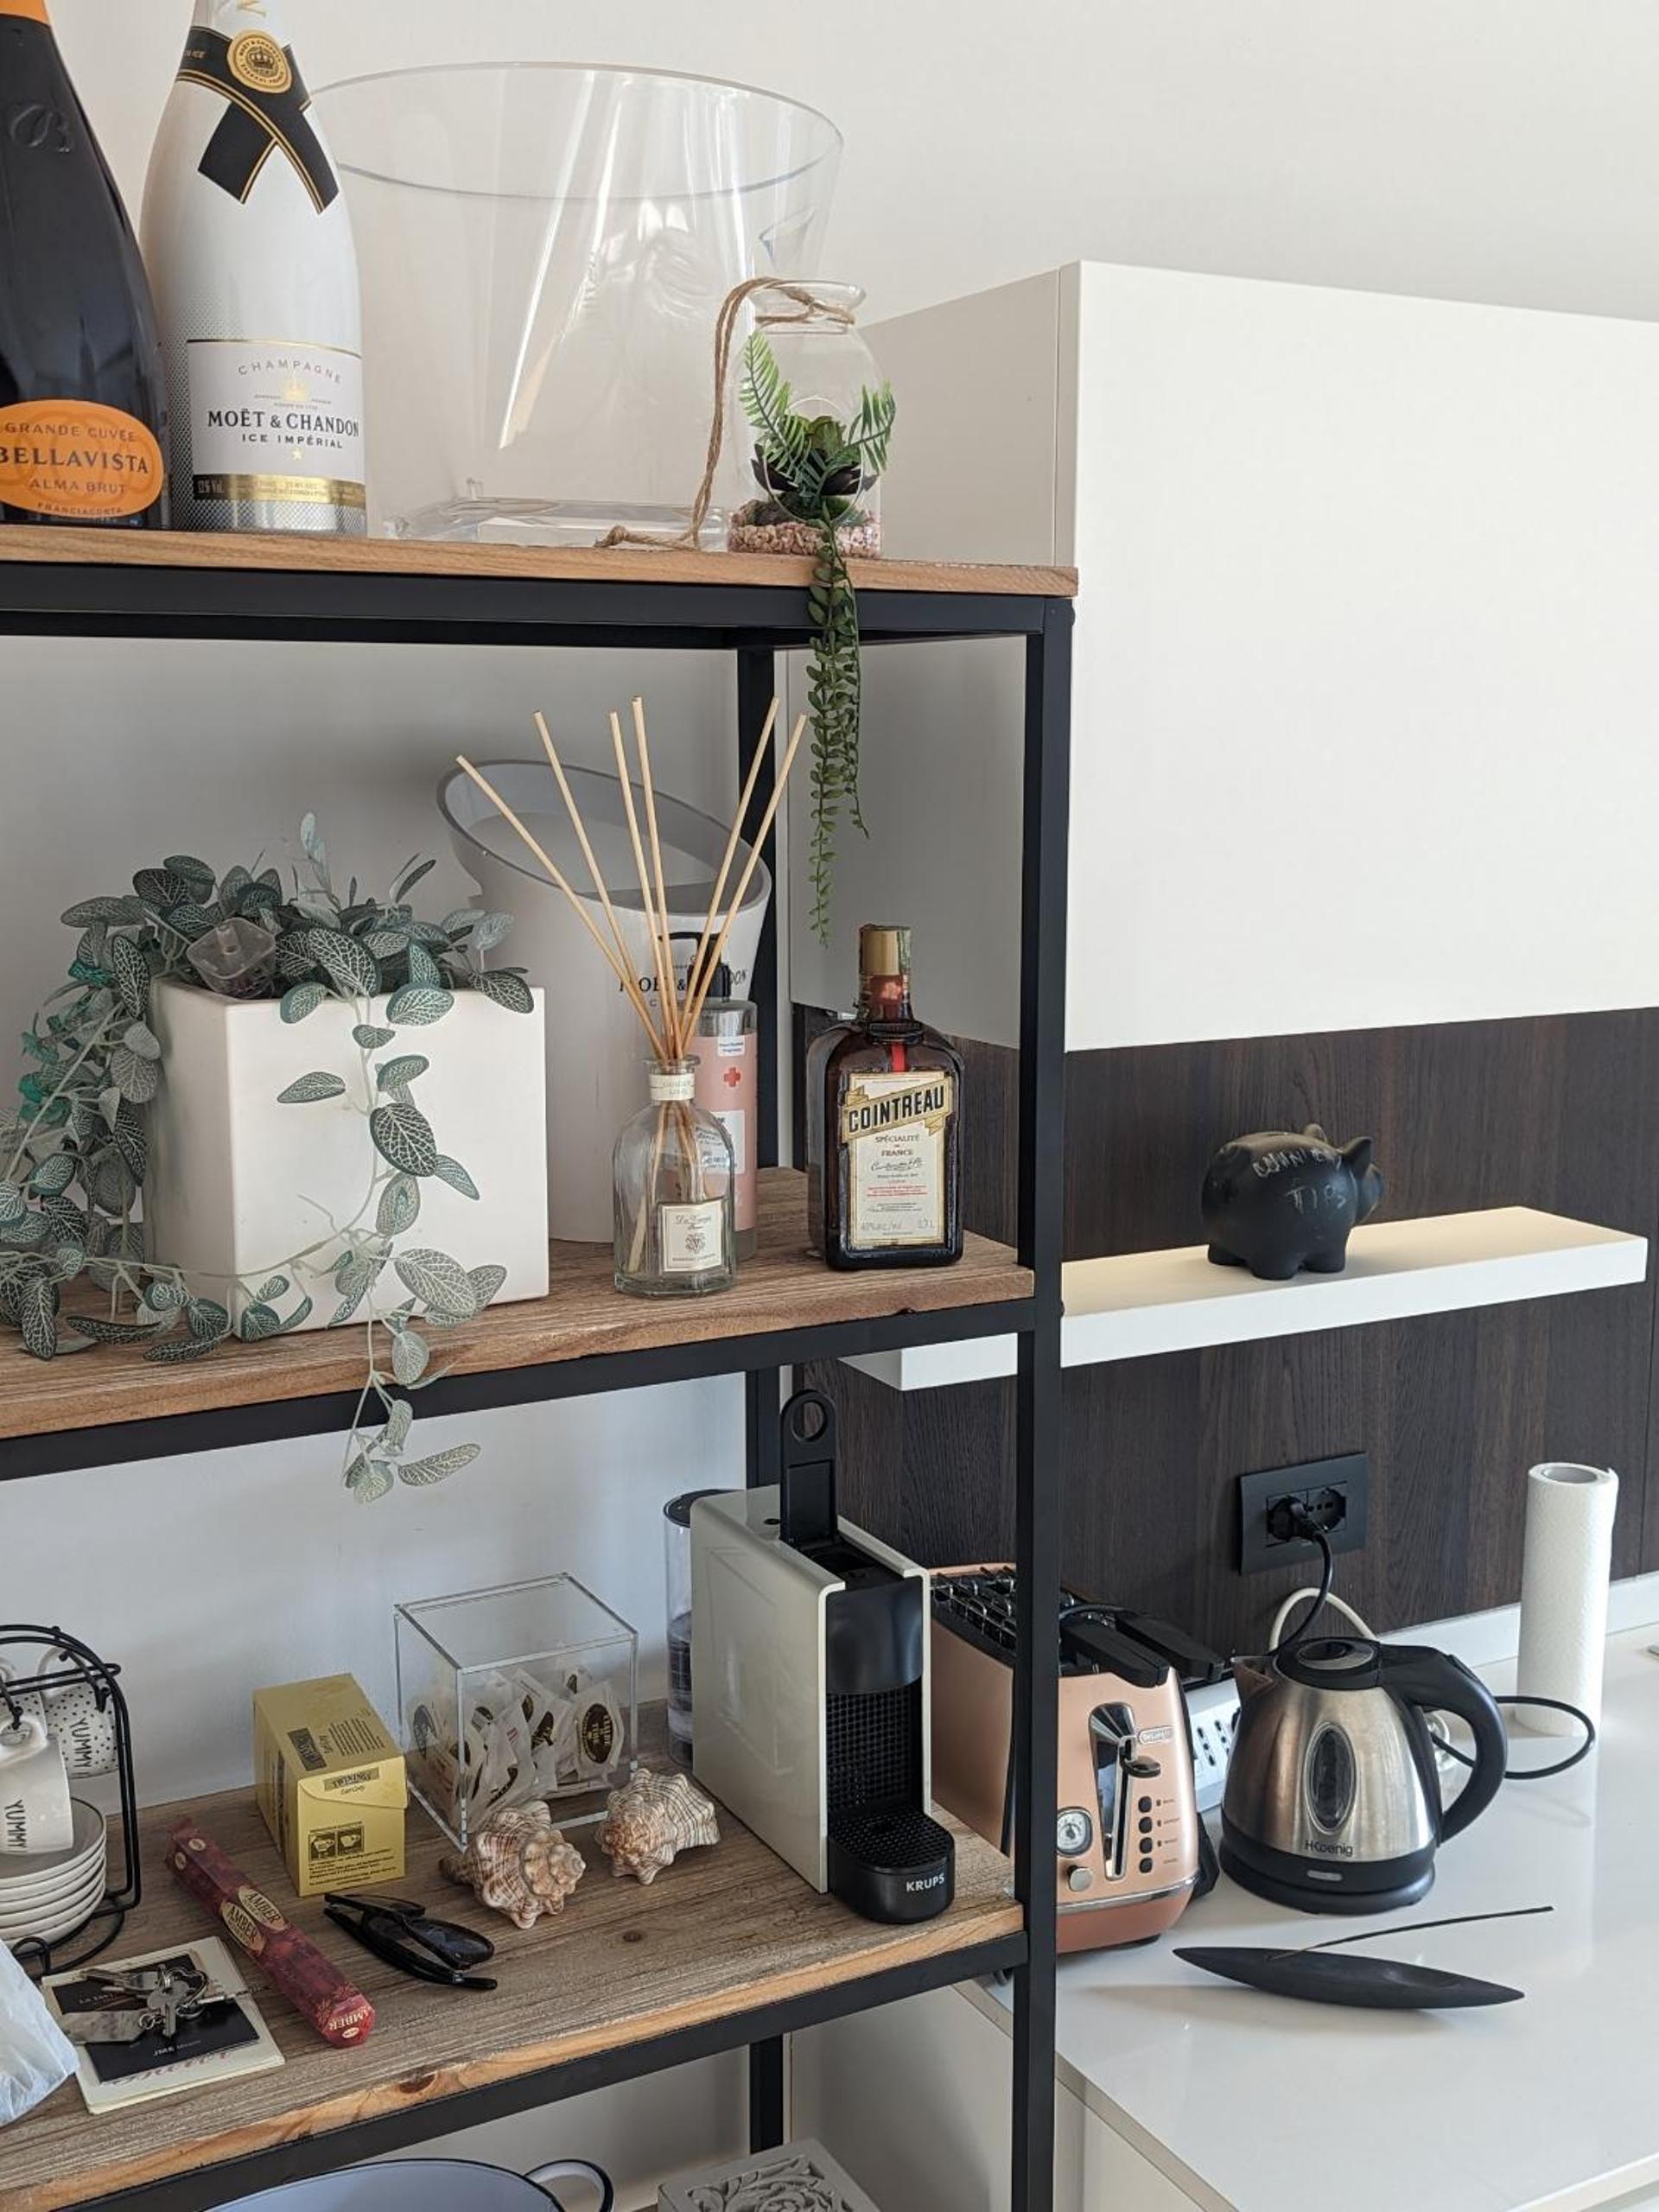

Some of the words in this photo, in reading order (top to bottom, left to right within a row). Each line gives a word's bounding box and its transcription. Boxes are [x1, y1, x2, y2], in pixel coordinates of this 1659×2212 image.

[238, 359, 342, 384] CHAMPAGNE
[4, 422, 80, 437] GRANDE
[87, 427, 137, 443] CUVÉE
[207, 408, 265, 428] MOËT
[270, 415, 283, 429] &
[286, 413, 359, 437] CHANDON
[242, 433, 269, 442] ICE
[277, 434, 343, 449] IMPÉRIAL
[0, 445, 149, 474] BELLAVISTA
[29, 478, 79, 491] ALMA
[86, 483, 127, 494] BRUT
[849, 1085, 944, 1133] COINTREAU
[69, 1717, 92, 1769] YUMMY
[4, 1799, 28, 1848] YUMMY
[906, 1872, 944, 1892] KRUPS
[245, 1892, 282, 1924] AMBER
[227, 1905, 258, 1943] AMBER
